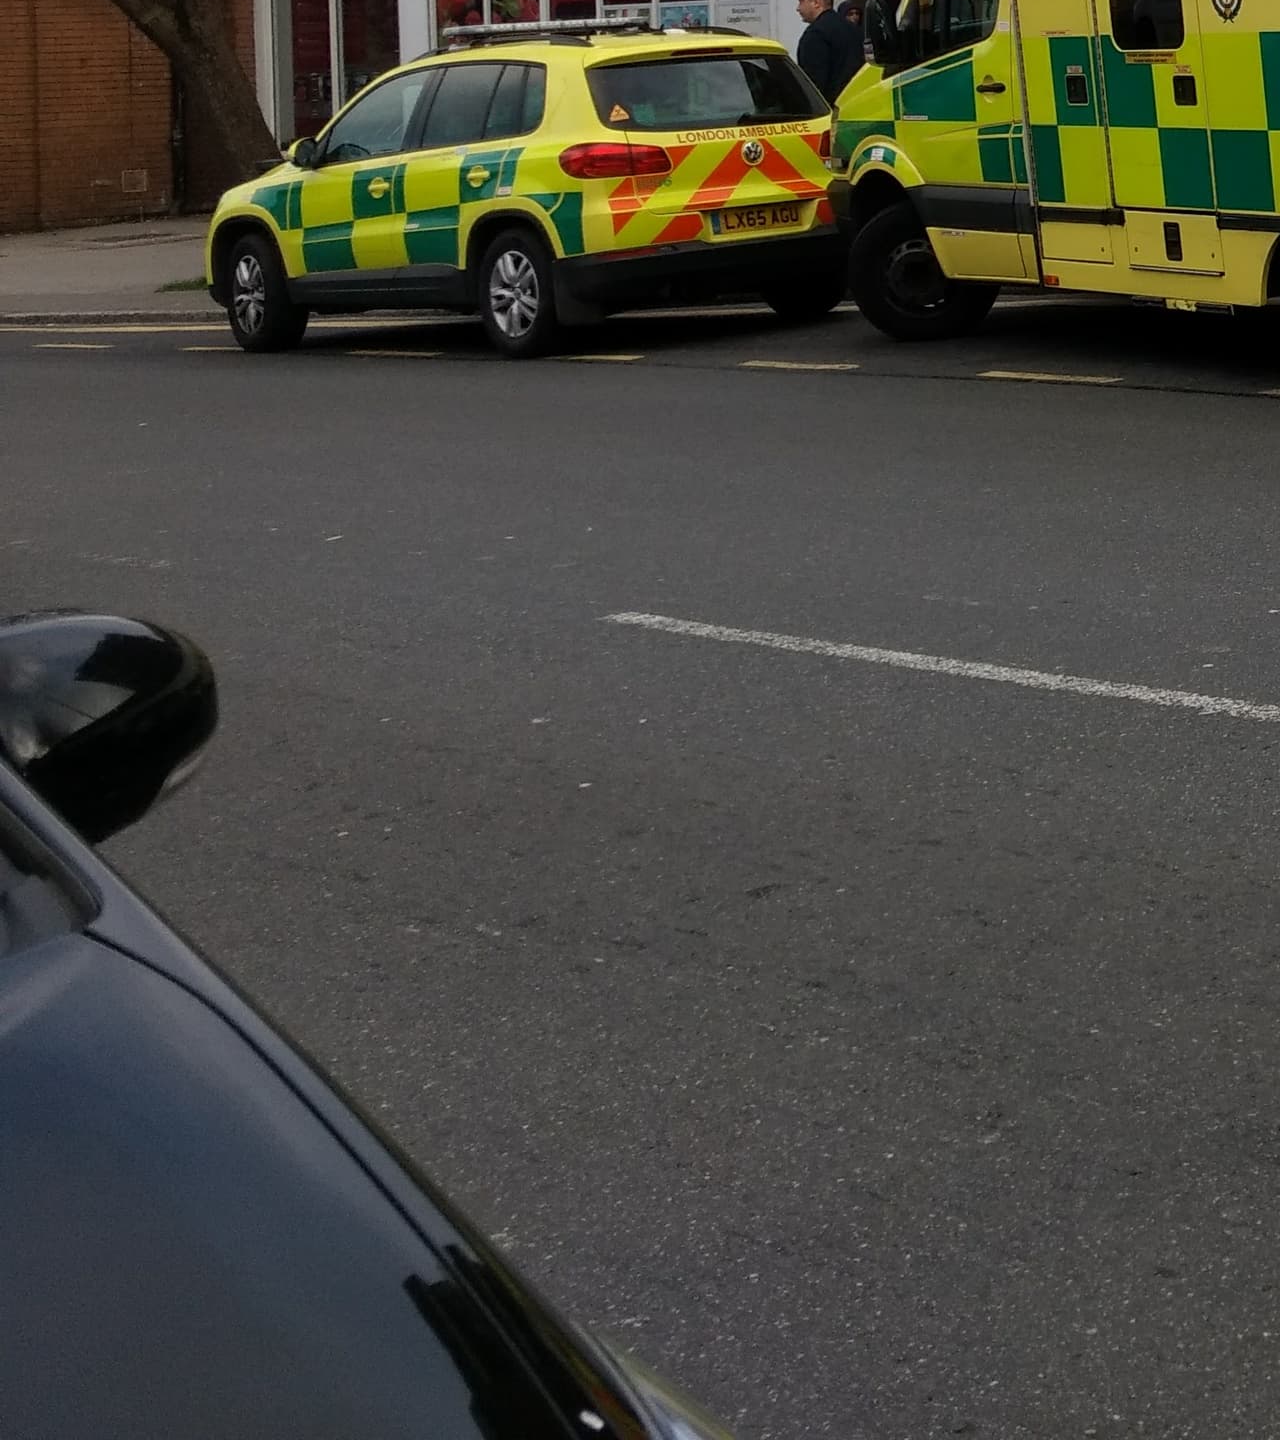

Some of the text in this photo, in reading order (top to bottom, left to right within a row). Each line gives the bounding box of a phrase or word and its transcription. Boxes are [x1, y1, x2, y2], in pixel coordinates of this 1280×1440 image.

[677, 122, 810, 144] LONDON AMBULANCE
[723, 210, 766, 230] LX65
